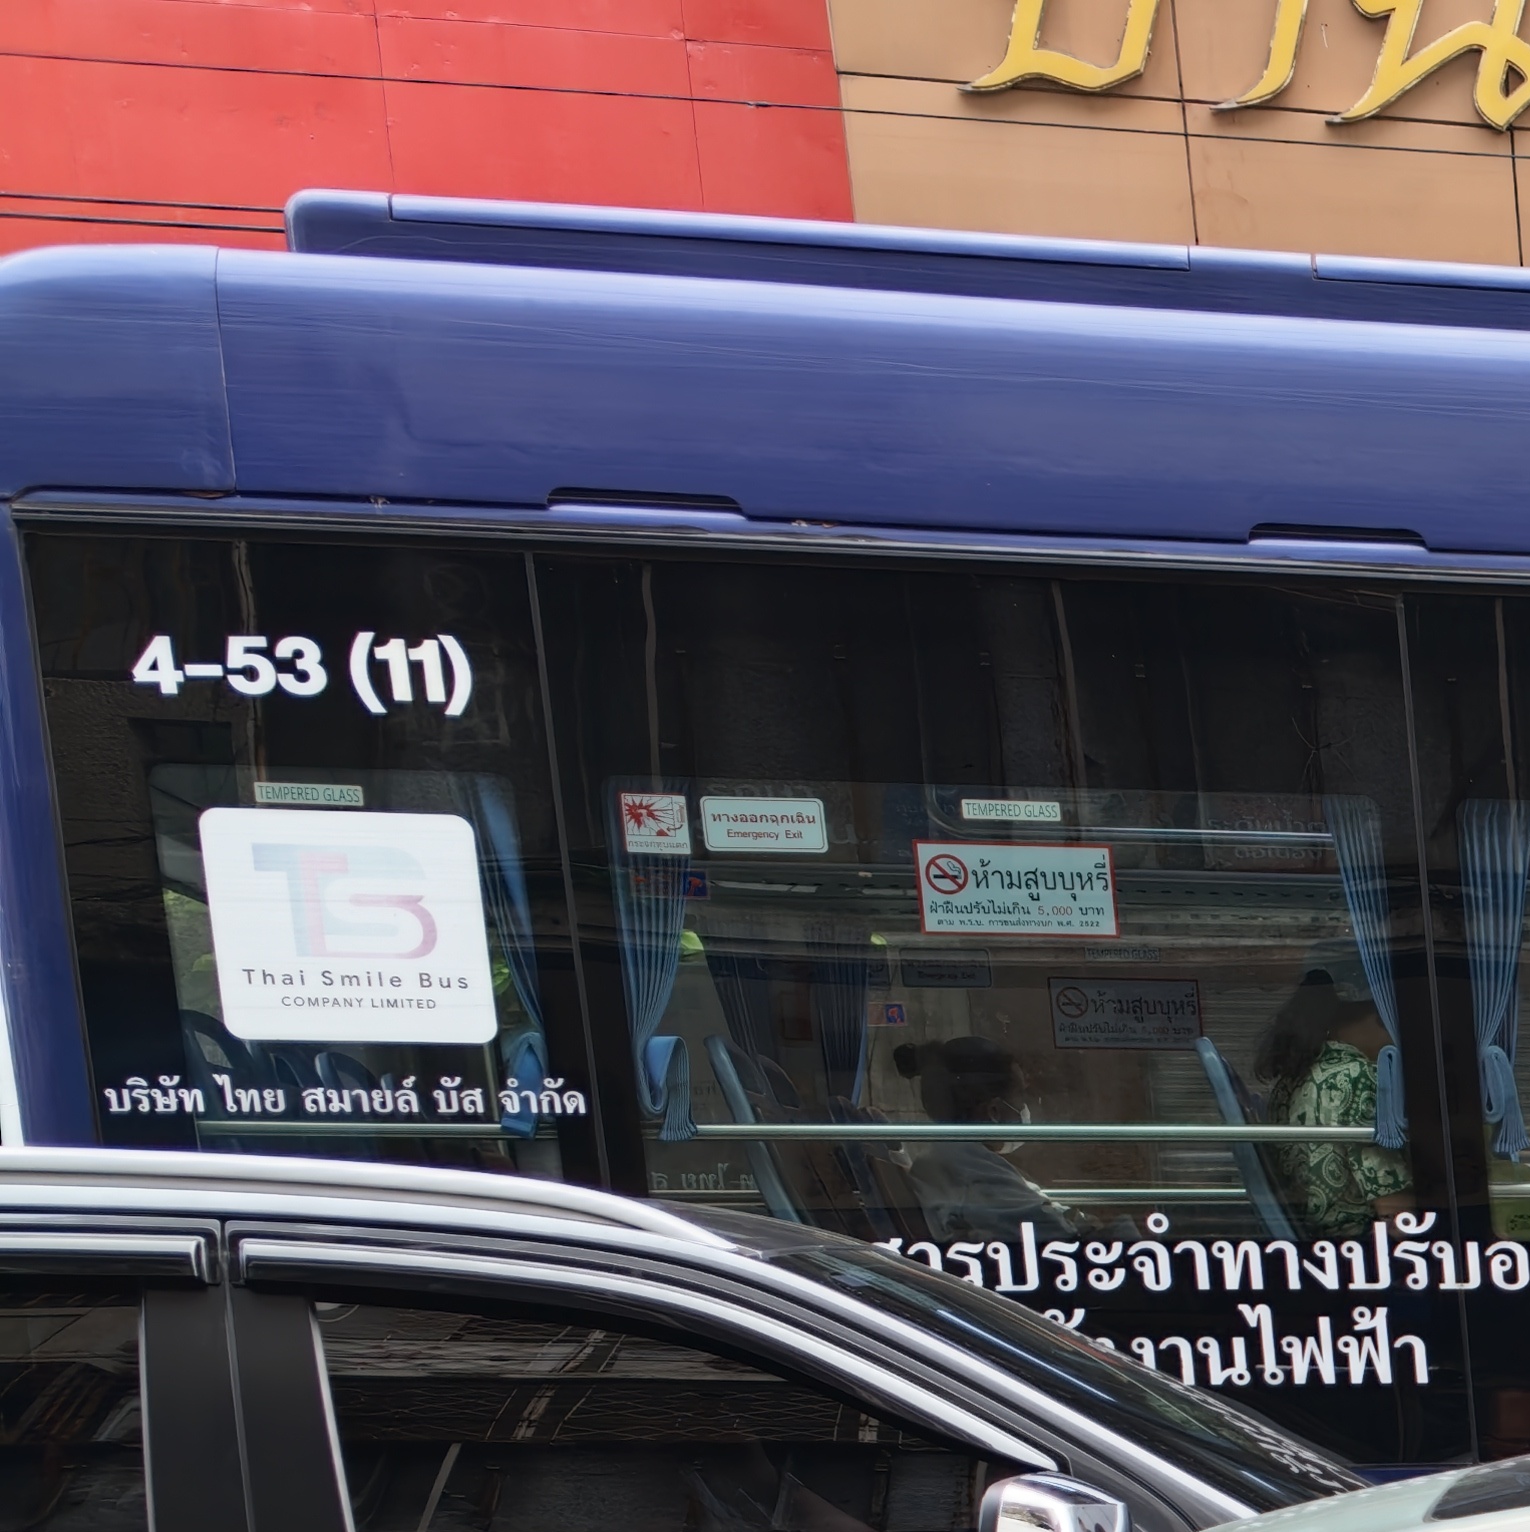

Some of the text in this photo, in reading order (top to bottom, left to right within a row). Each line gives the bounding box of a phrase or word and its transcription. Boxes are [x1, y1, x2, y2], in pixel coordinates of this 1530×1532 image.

[131, 630, 473, 716] 4-53 (11)
[257, 785, 360, 804] TEMPERED GLASS
[965, 803, 1058, 818] TEMPERED GLASS
[727, 829, 803, 840] Emergency Exit
[972, 855, 1108, 901] ห้ามสูบบุหรี่
[1079, 906, 1104, 915] บาท
[242, 968, 469, 990] Thai Smile Bus
[281, 995, 437, 1010] COMPANY LIMITED
[104, 1073, 586, 1115] บริษัท ไทย สมายล์ บัส จำกัด
